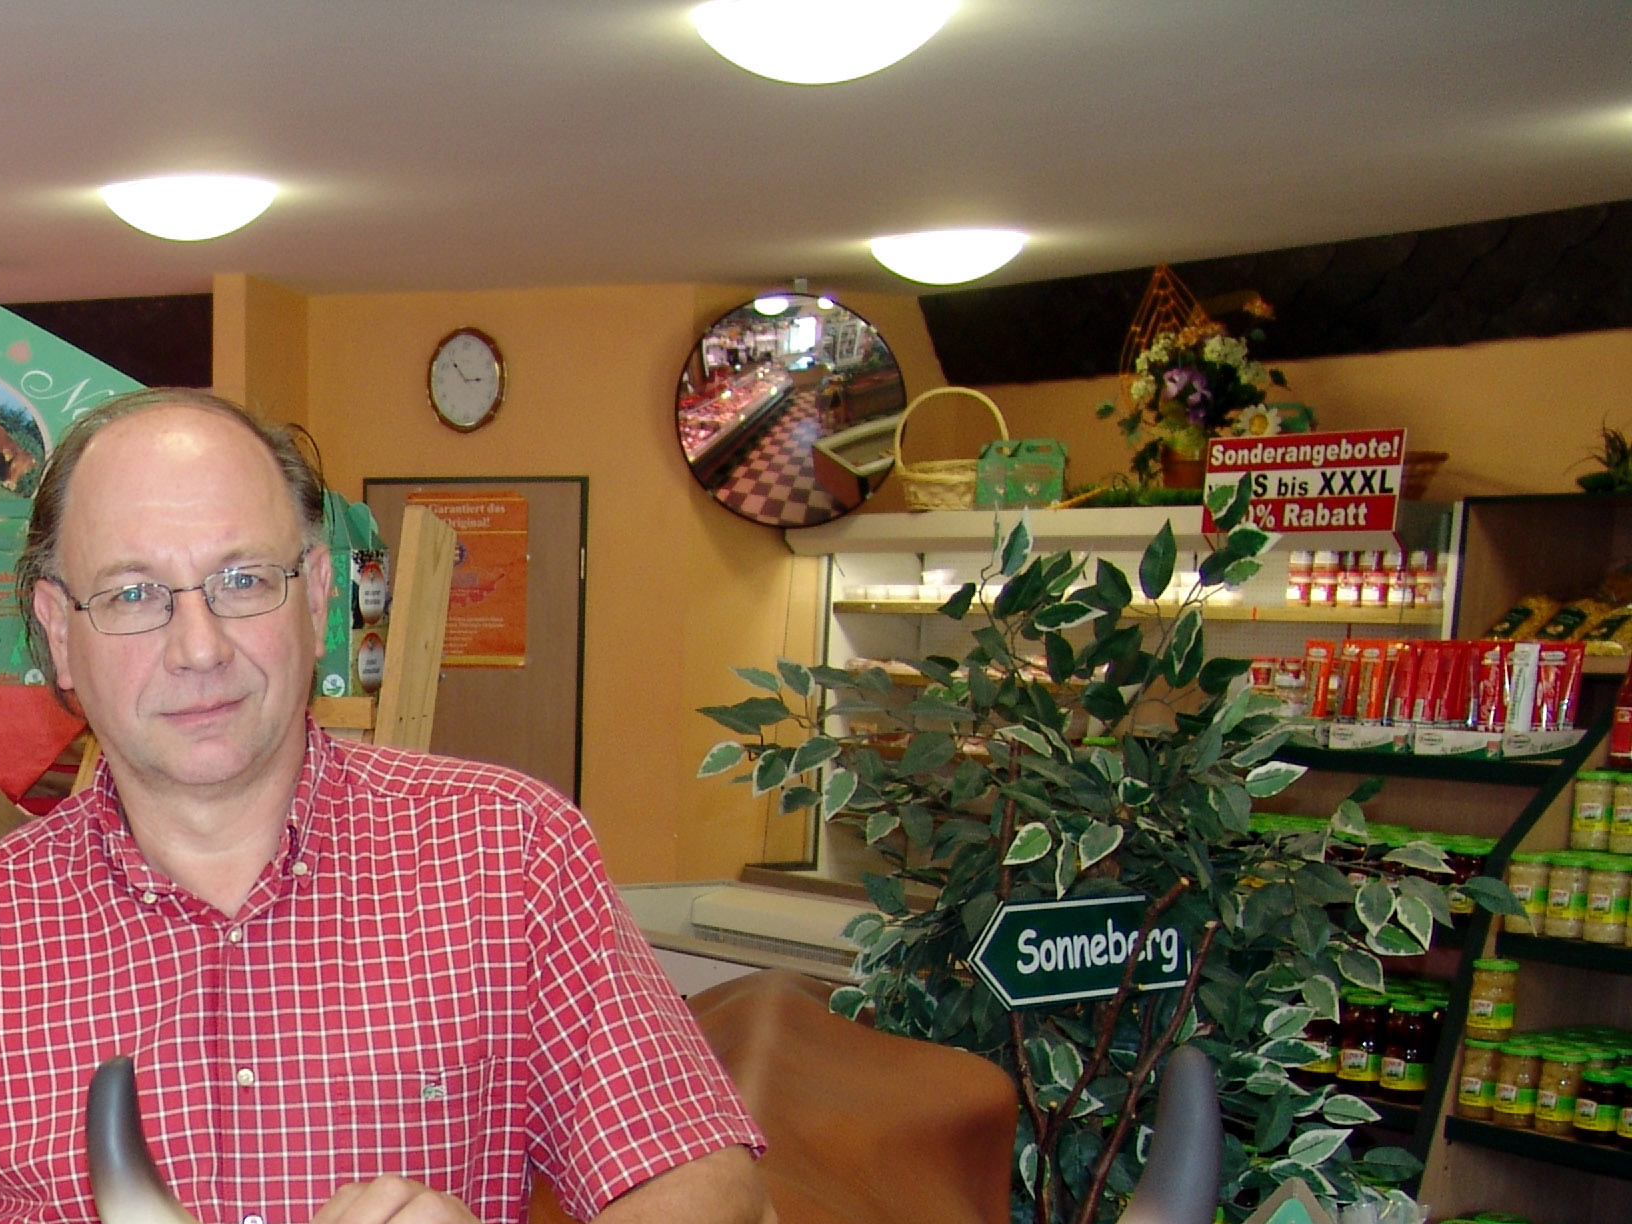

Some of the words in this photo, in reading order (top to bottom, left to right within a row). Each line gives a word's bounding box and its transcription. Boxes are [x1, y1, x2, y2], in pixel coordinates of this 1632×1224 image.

[1210, 435, 1400, 466] Sonderangebote!
[1277, 477, 1308, 496] bis
[1318, 469, 1393, 495] XXXL
[428, 503, 485, 515] Garantiert
[487, 503, 506, 514] das
[1283, 502, 1368, 527] Rabatt
